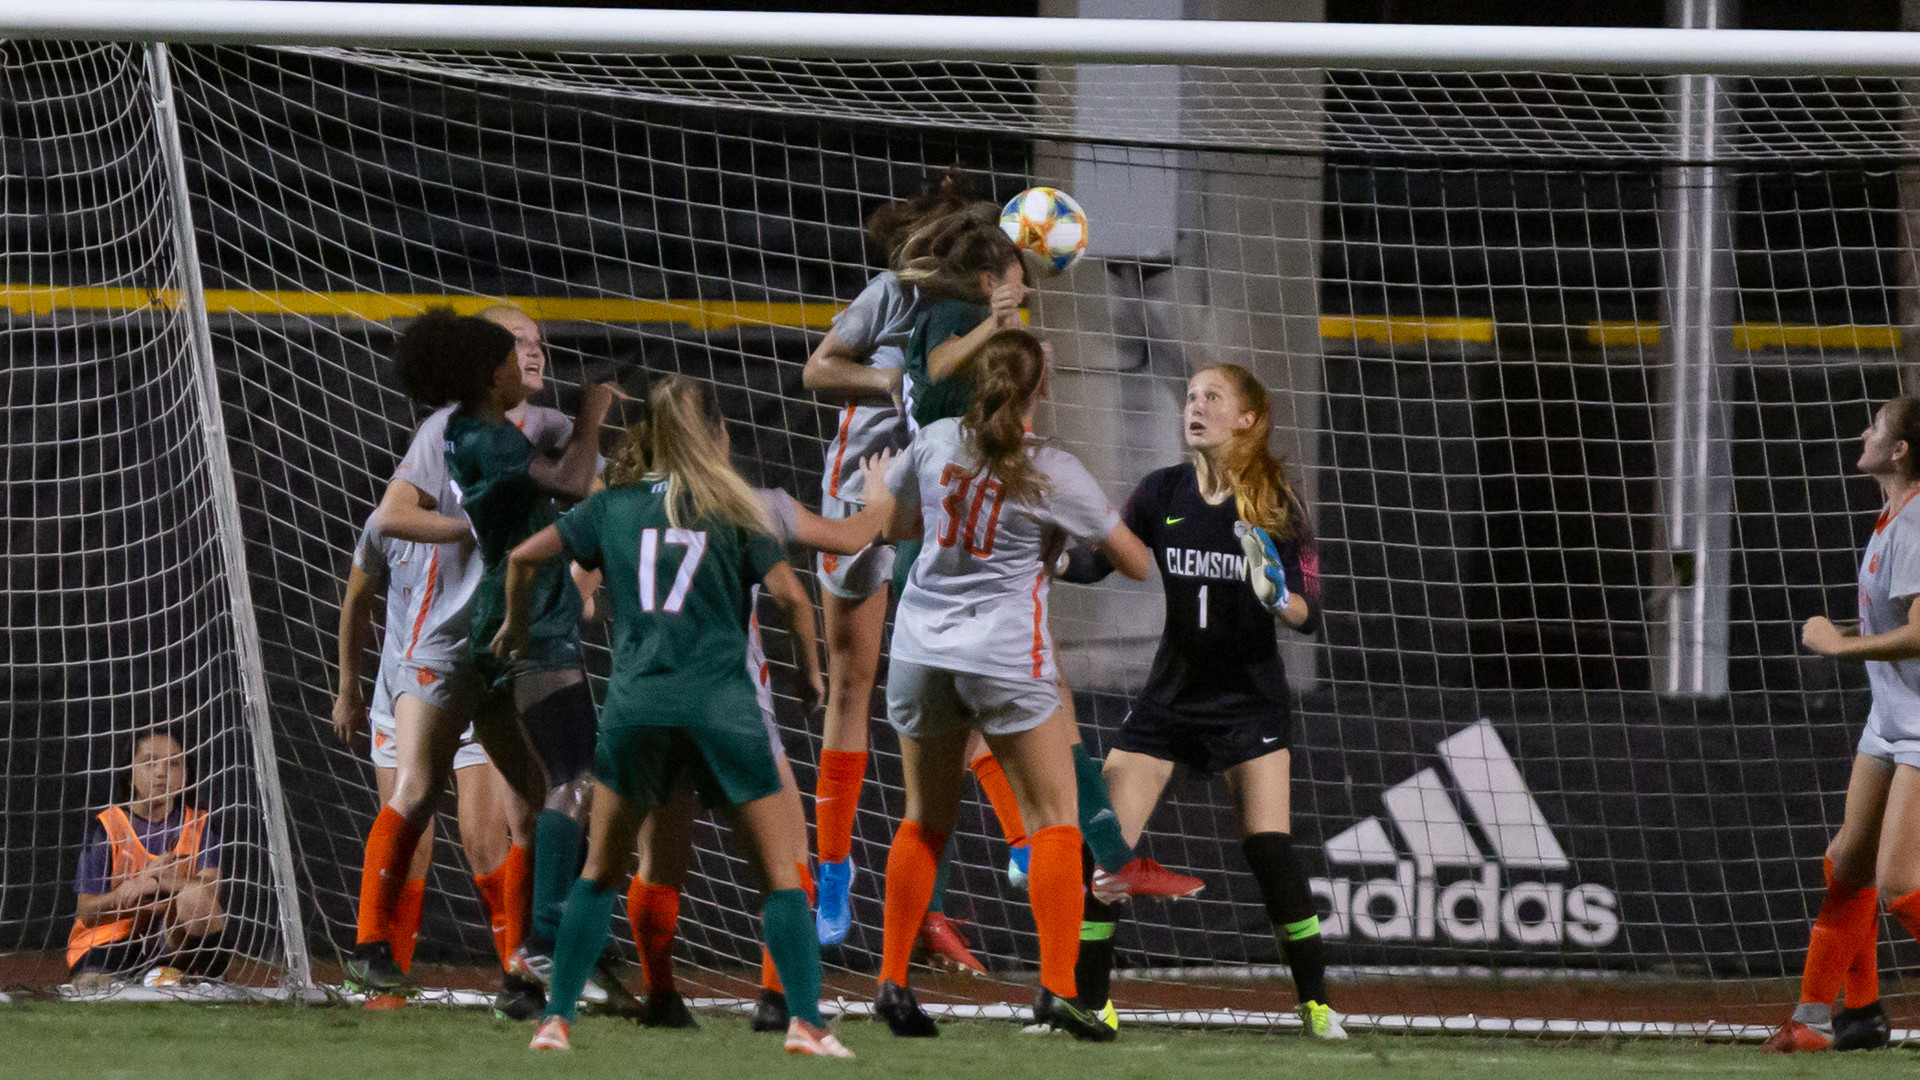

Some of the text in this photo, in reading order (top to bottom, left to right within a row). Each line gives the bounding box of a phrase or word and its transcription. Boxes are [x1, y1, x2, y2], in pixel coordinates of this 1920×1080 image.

[937, 463, 1007, 559] 30
[639, 528, 707, 612] 17
[1166, 547, 1249, 582] CLEMSON
[1198, 585, 1208, 629] 1
[1309, 860, 1619, 947] adidas
